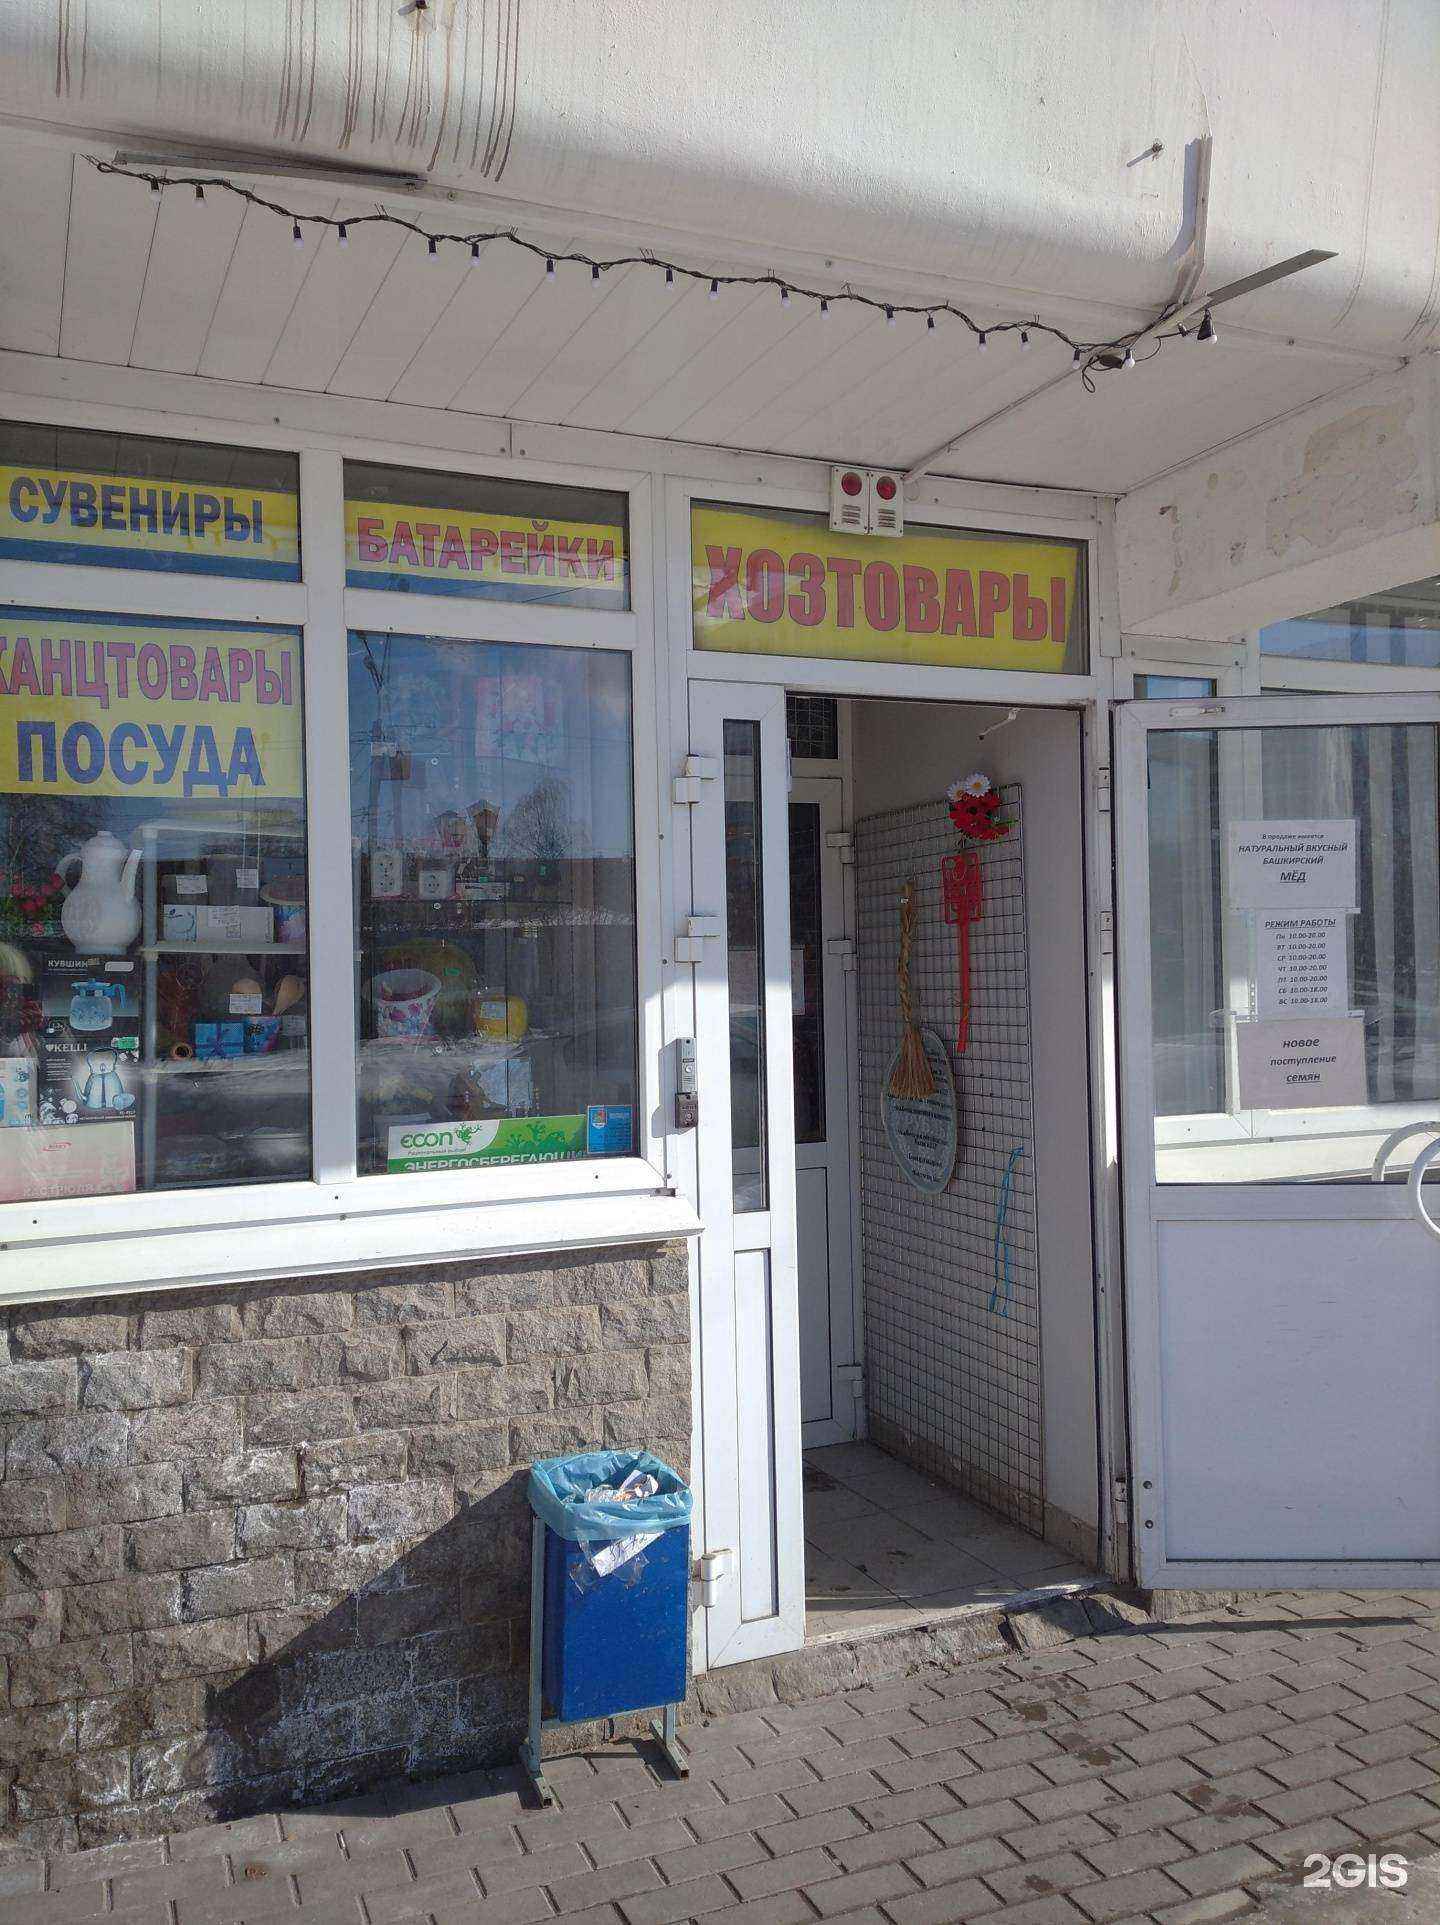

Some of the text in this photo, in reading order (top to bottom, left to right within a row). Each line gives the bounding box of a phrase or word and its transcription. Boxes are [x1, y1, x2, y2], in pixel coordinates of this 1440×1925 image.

[8, 476, 264, 545] СУВЕНИРЫ
[356, 517, 615, 582] БАТАРЕЙКИ
[704, 544, 1067, 643] ХОЗТОВАРЫ
[16, 719, 267, 798] ПОСУДА
[1238, 842, 1349, 853] НАТУРАЛЬНЫЙ ВКУСНЫЙ
[1262, 855, 1324, 865] БАШКИРСКИЙ
[1280, 869, 1308, 883] МЁД
[1264, 918, 1337, 928] РЕЖИМ РАБОТЫ
[48, 959, 88, 968] КУВШИН
[1282, 1038, 1320, 1049] новое
[1270, 1055, 1337, 1067] поступление
[1286, 1072, 1321, 1083] семян
